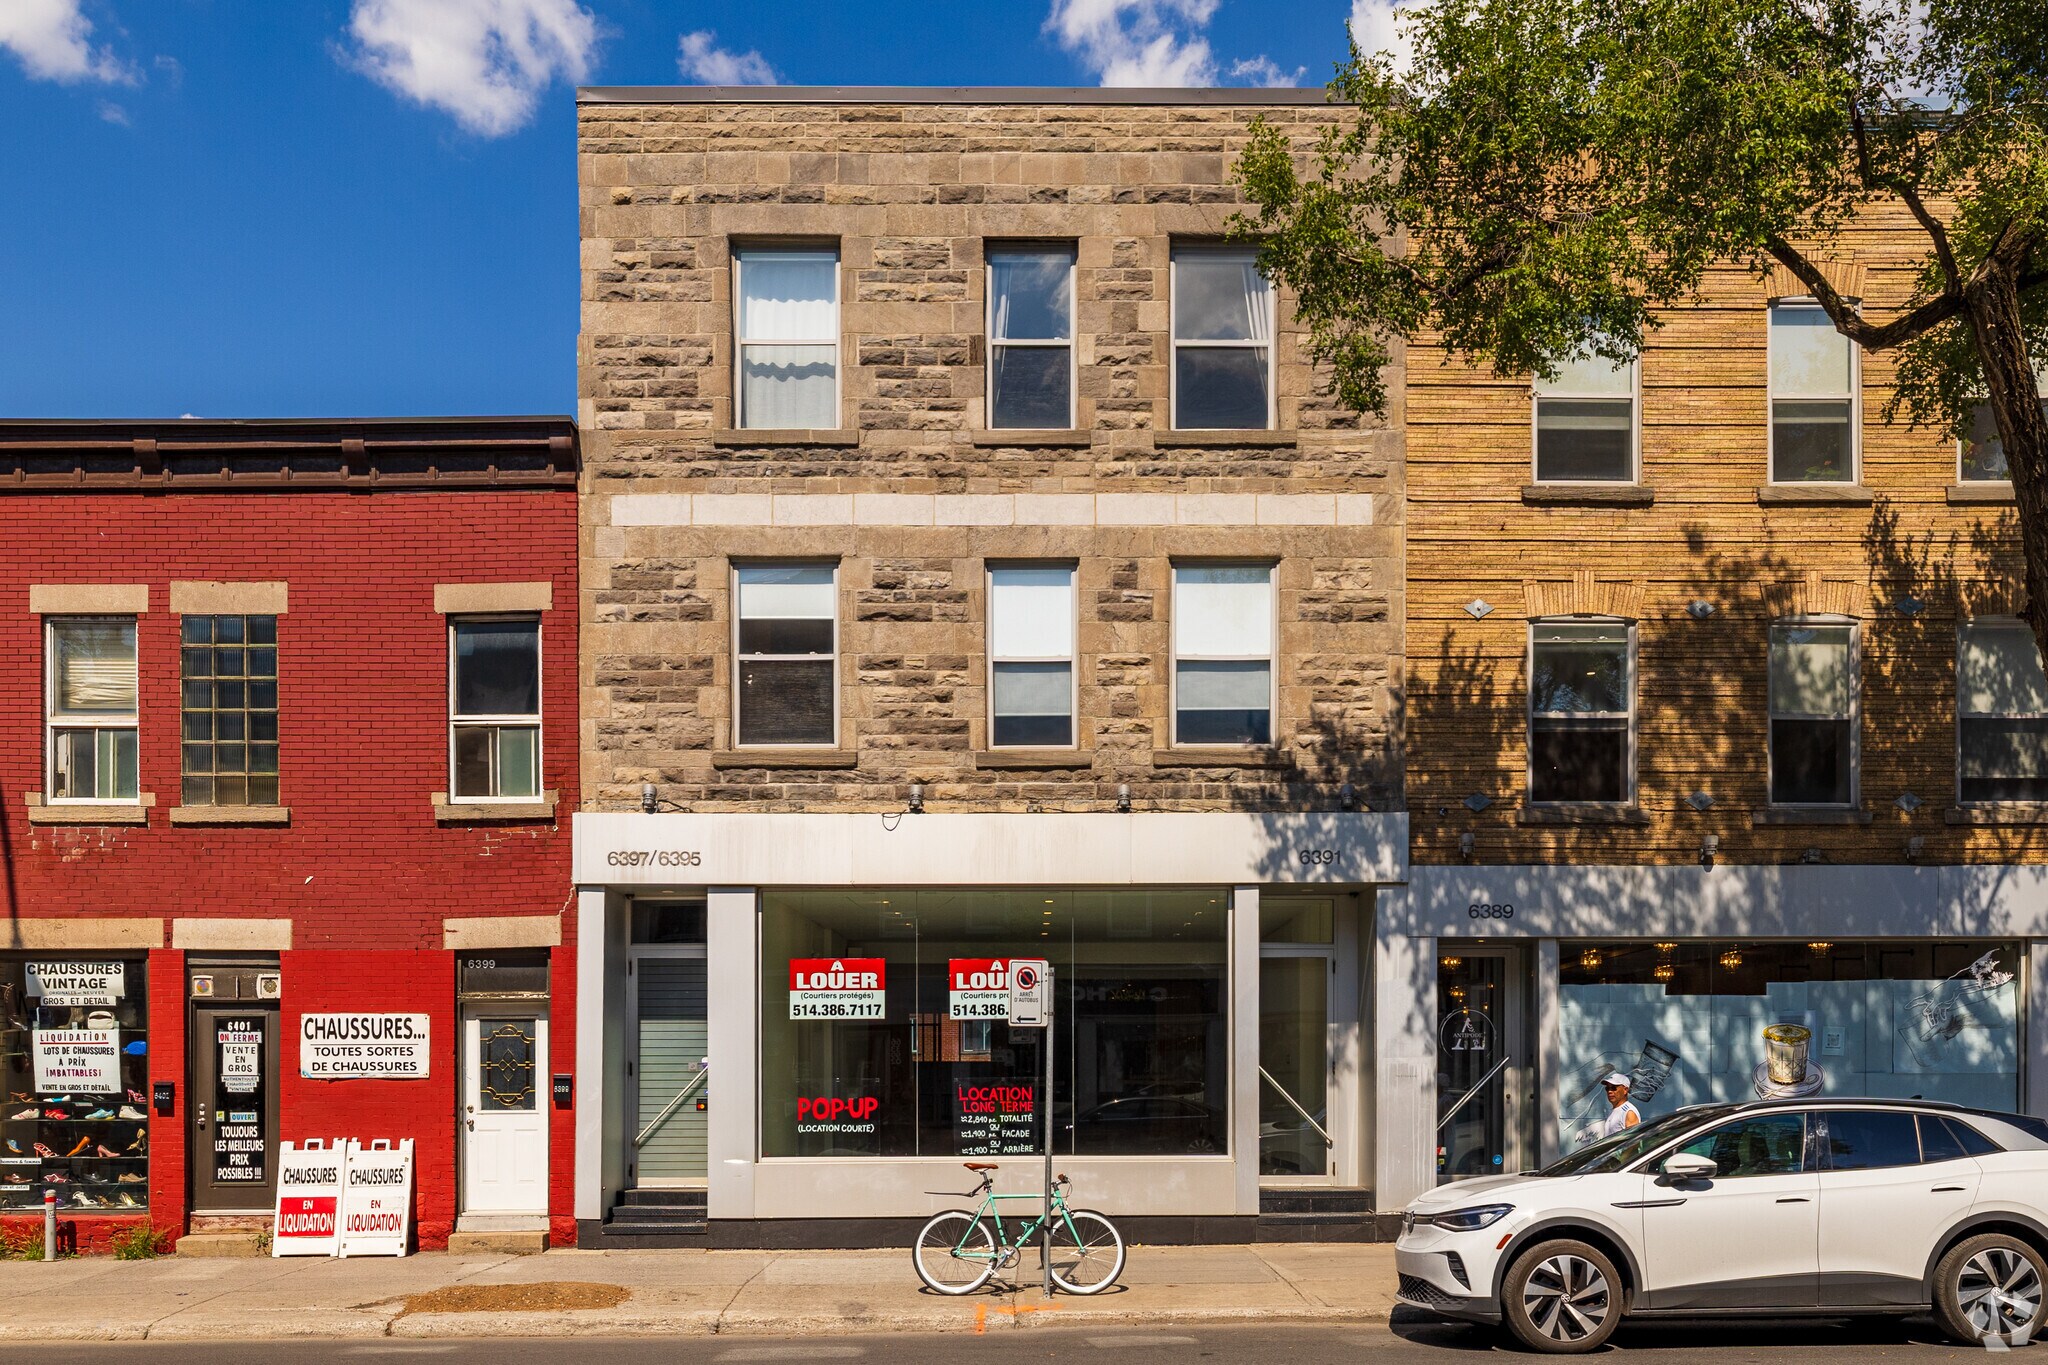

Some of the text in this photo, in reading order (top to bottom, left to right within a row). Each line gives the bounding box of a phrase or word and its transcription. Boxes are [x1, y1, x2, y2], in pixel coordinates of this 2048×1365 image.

[607, 850, 702, 866] 6397/6395
[1300, 850, 1341, 865] 6391
[1468, 904, 1514, 919] 6389
[27, 964, 122, 975] CHAUSSURES
[468, 960, 496, 969] 6399
[796, 973, 878, 989] LOUER
[956, 973, 1009, 989] LOU
[43, 997, 65, 1005] GROS
[71, 997, 80, 1005] ET
[839, 992, 874, 1000] protégés)
[793, 1004, 881, 1016] 514.386.7117
[228, 1021, 250, 1031] 6401
[304, 1017, 426, 1040] CHAUSSURES...
[44, 1047, 115, 1055] LOTS DE CHAUSSURES
[314, 1047, 414, 1057] TOUTES SORTES
[68, 1057, 86, 1066] PRIX
[312, 1062, 417, 1072] DE CHAUSSURES
[958, 1087, 1033, 1101] LOCATION
[797, 1097, 879, 1121] POP-UP
[963, 1101, 1033, 1113] LONG TERME
[1000, 1113, 1033, 1122] TOTALITÉ
[221, 1126, 257, 1138] TOUJOURS
[797, 1124, 875, 1133] (LOCATION COURTE)
[215, 1140, 264, 1151] LES MEILLEURS
[990, 1140, 1001, 1148] OU
[1003, 1144, 1034, 1153] ARRIÈRE
[230, 1154, 249, 1166] PRIX
[218, 1167, 253, 1180] POSSIBLES
[284, 1167, 337, 1185] CHAUSSURES
[350, 1168, 404, 1186] CHAUSSURES
[303, 1200, 313, 1210] EN
[370, 1200, 381, 1209] EN
[280, 1213, 334, 1233] LIQUIDATION
[347, 1214, 402, 1232] LIQUIDATION
